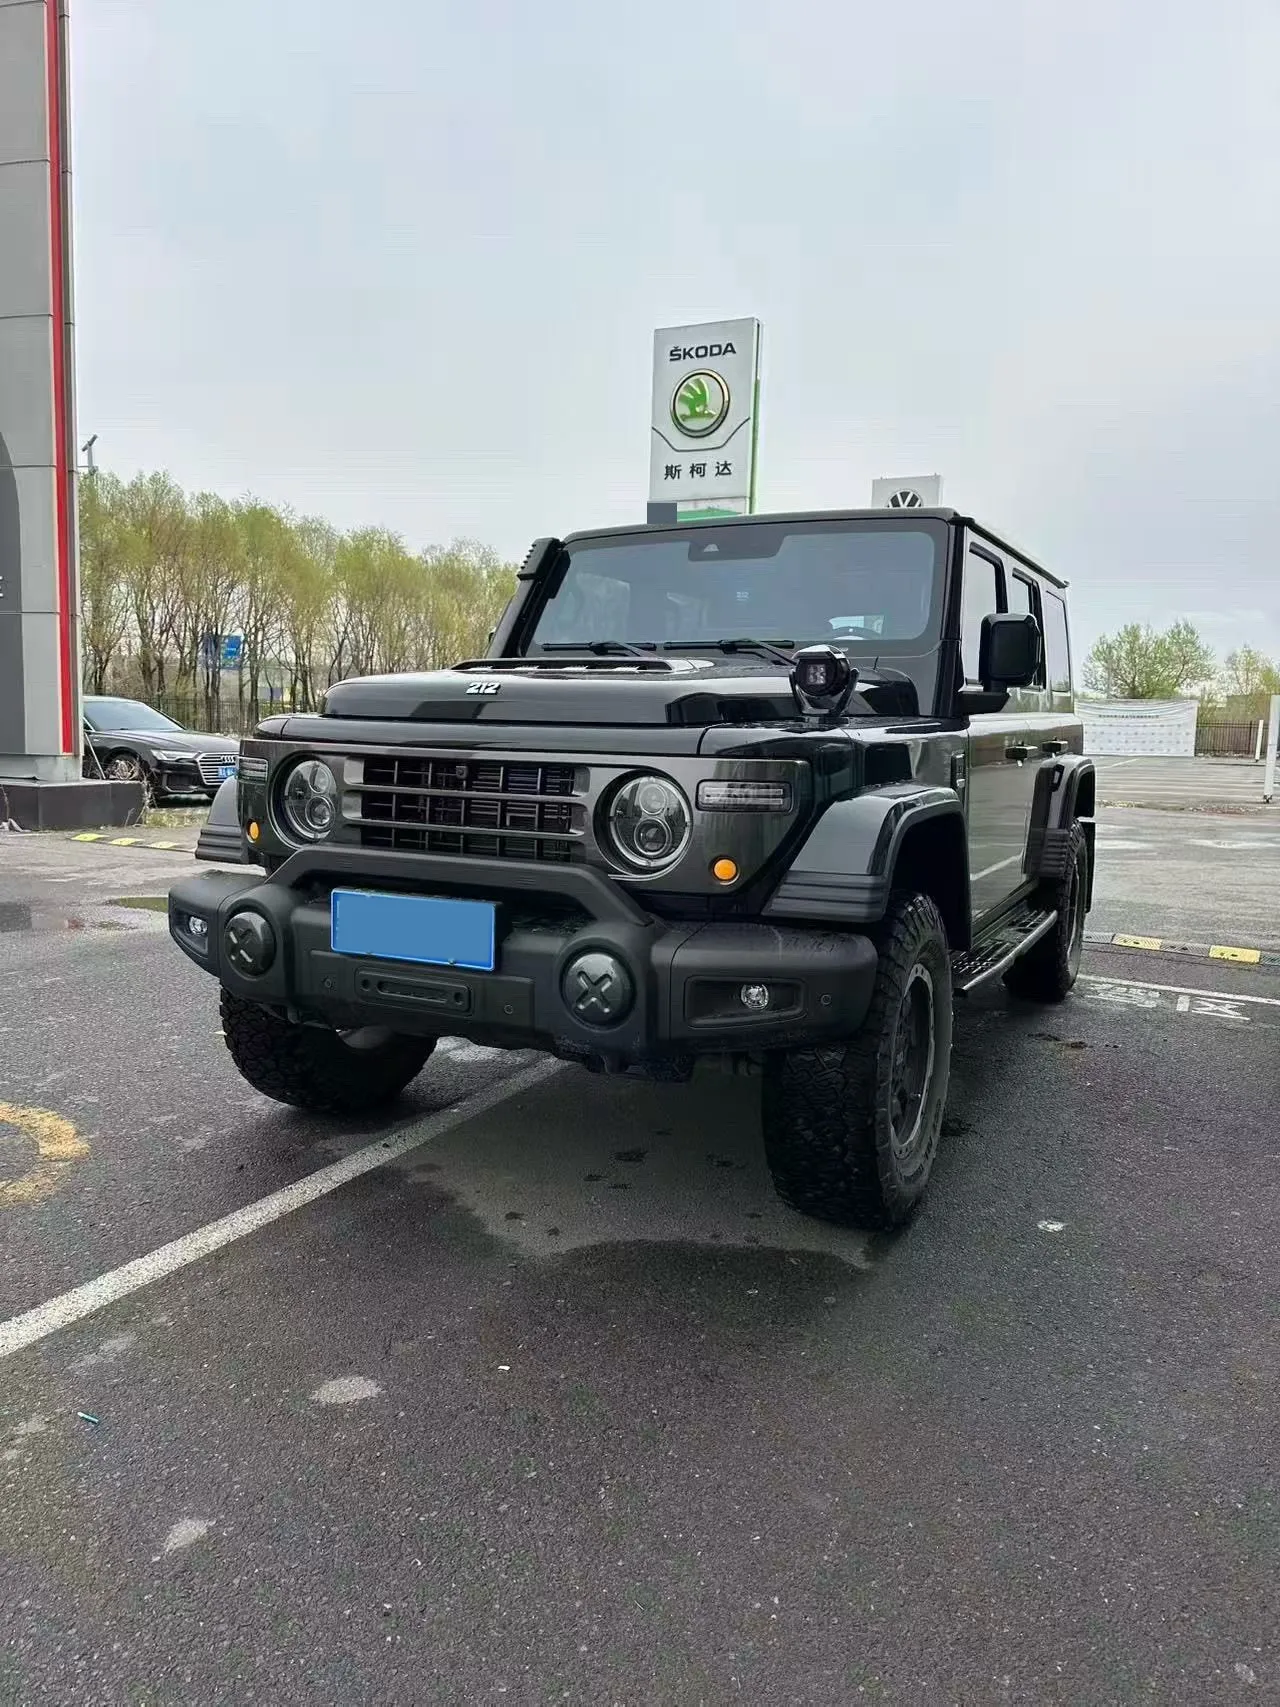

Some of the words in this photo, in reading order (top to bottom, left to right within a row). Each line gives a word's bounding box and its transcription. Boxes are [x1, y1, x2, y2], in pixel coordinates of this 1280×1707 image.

[669, 342, 736, 362] ŠKODA
[664, 460, 732, 480] 斯柯达
[466, 681, 501, 695] 212
